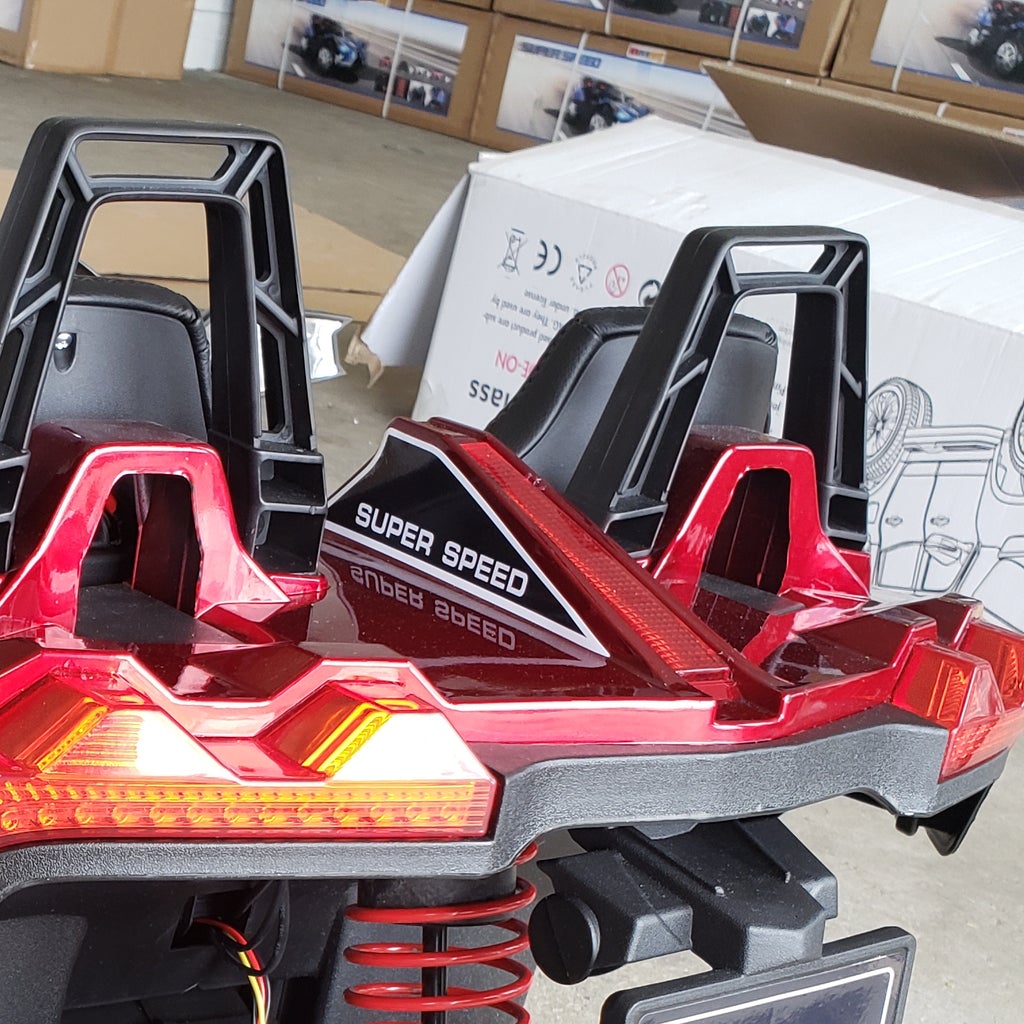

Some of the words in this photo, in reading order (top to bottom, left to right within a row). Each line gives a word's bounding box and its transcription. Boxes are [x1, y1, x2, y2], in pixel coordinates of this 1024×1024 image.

[495, 350, 535, 379] E-ON
[469, 379, 510, 407] lass
[354, 501, 435, 557] SUPER
[441, 540, 529, 598] SPEED
